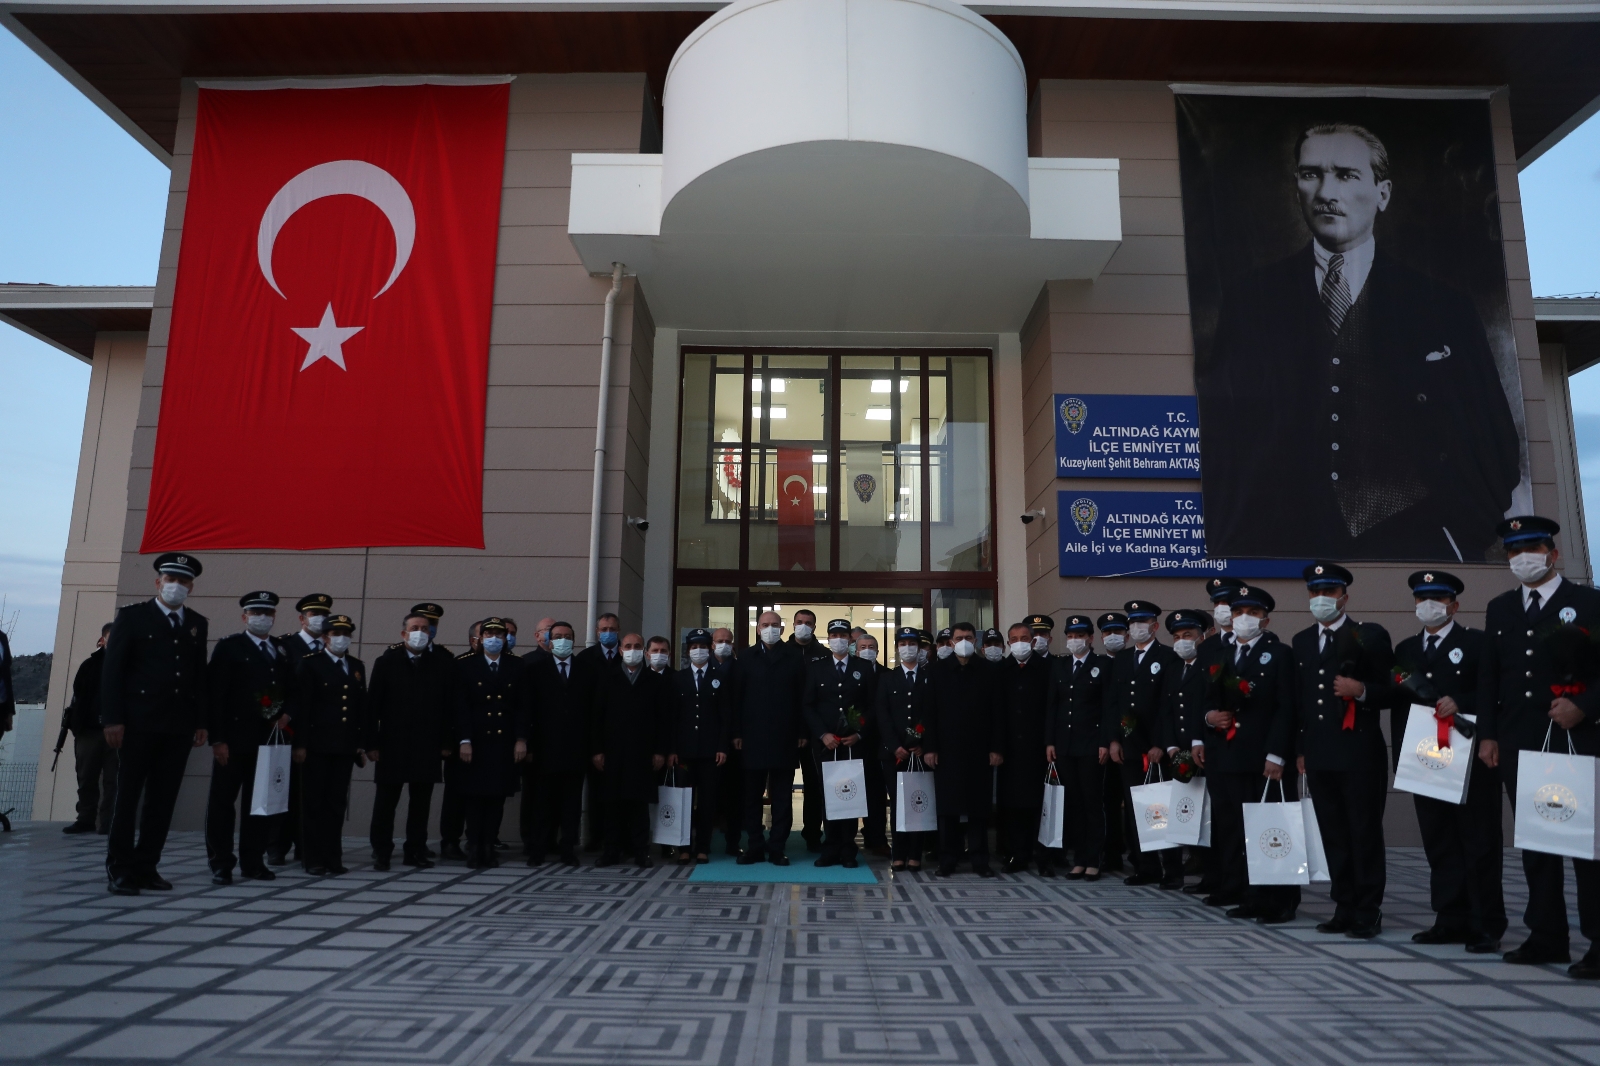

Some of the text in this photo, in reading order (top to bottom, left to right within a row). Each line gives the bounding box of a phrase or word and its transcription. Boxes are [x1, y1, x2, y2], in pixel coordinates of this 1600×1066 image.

[1166, 412, 1190, 423] T.C.
[1092, 425, 1160, 438] ALTINDAĞ
[1089, 440, 1119, 455] İLÇE
[1122, 440, 1181, 453] EMNİYET
[1060, 456, 1200, 472] Kuzeykent Şehit Behram AKTAŞ
[1174, 500, 1197, 510] T.C.
[1106, 512, 1169, 525] ALTINDAĞ
[1102, 526, 1131, 541] İLÇE
[1134, 526, 1189, 539] EMNİYET
[1065, 542, 1088, 553] Aile
[1091, 540, 1105, 556] İçi
[1108, 545, 1122, 553] ve
[1125, 543, 1167, 554] Kadına
[1169, 543, 1201, 556] Karşı
[1150, 557, 1227, 571] Büro Amirliği
